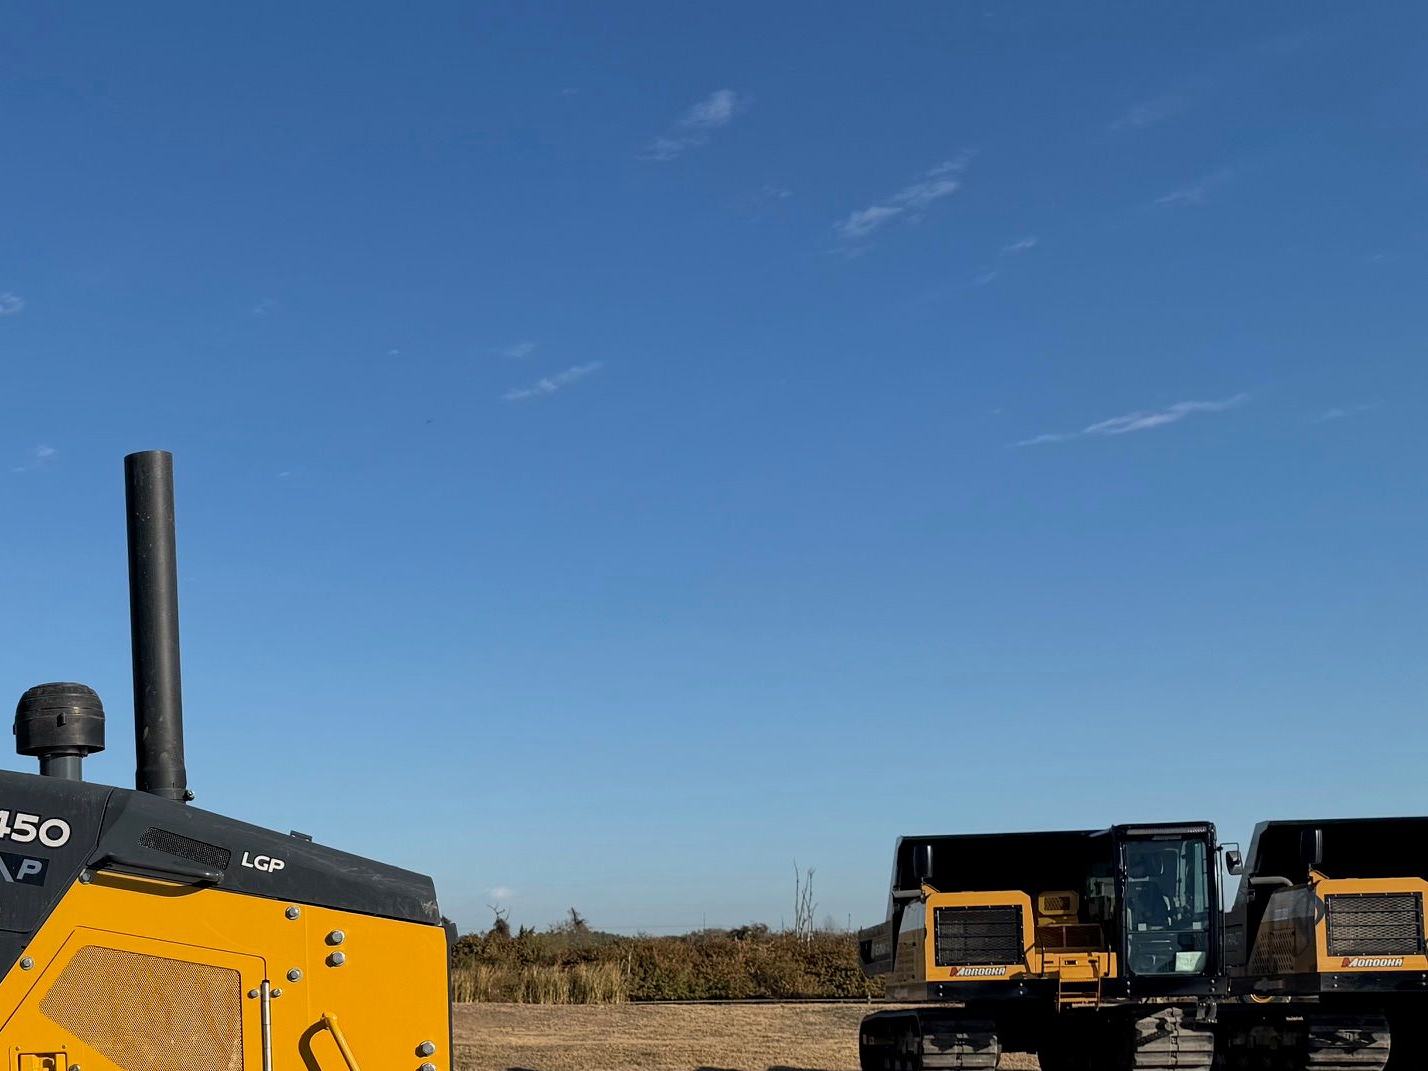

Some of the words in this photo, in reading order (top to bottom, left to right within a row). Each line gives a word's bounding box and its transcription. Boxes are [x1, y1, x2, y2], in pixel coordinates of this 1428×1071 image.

[241, 851, 285, 873] LGP
[1341, 957, 1404, 968] MOROOKA
[950, 967, 1006, 977] MOROOKA
